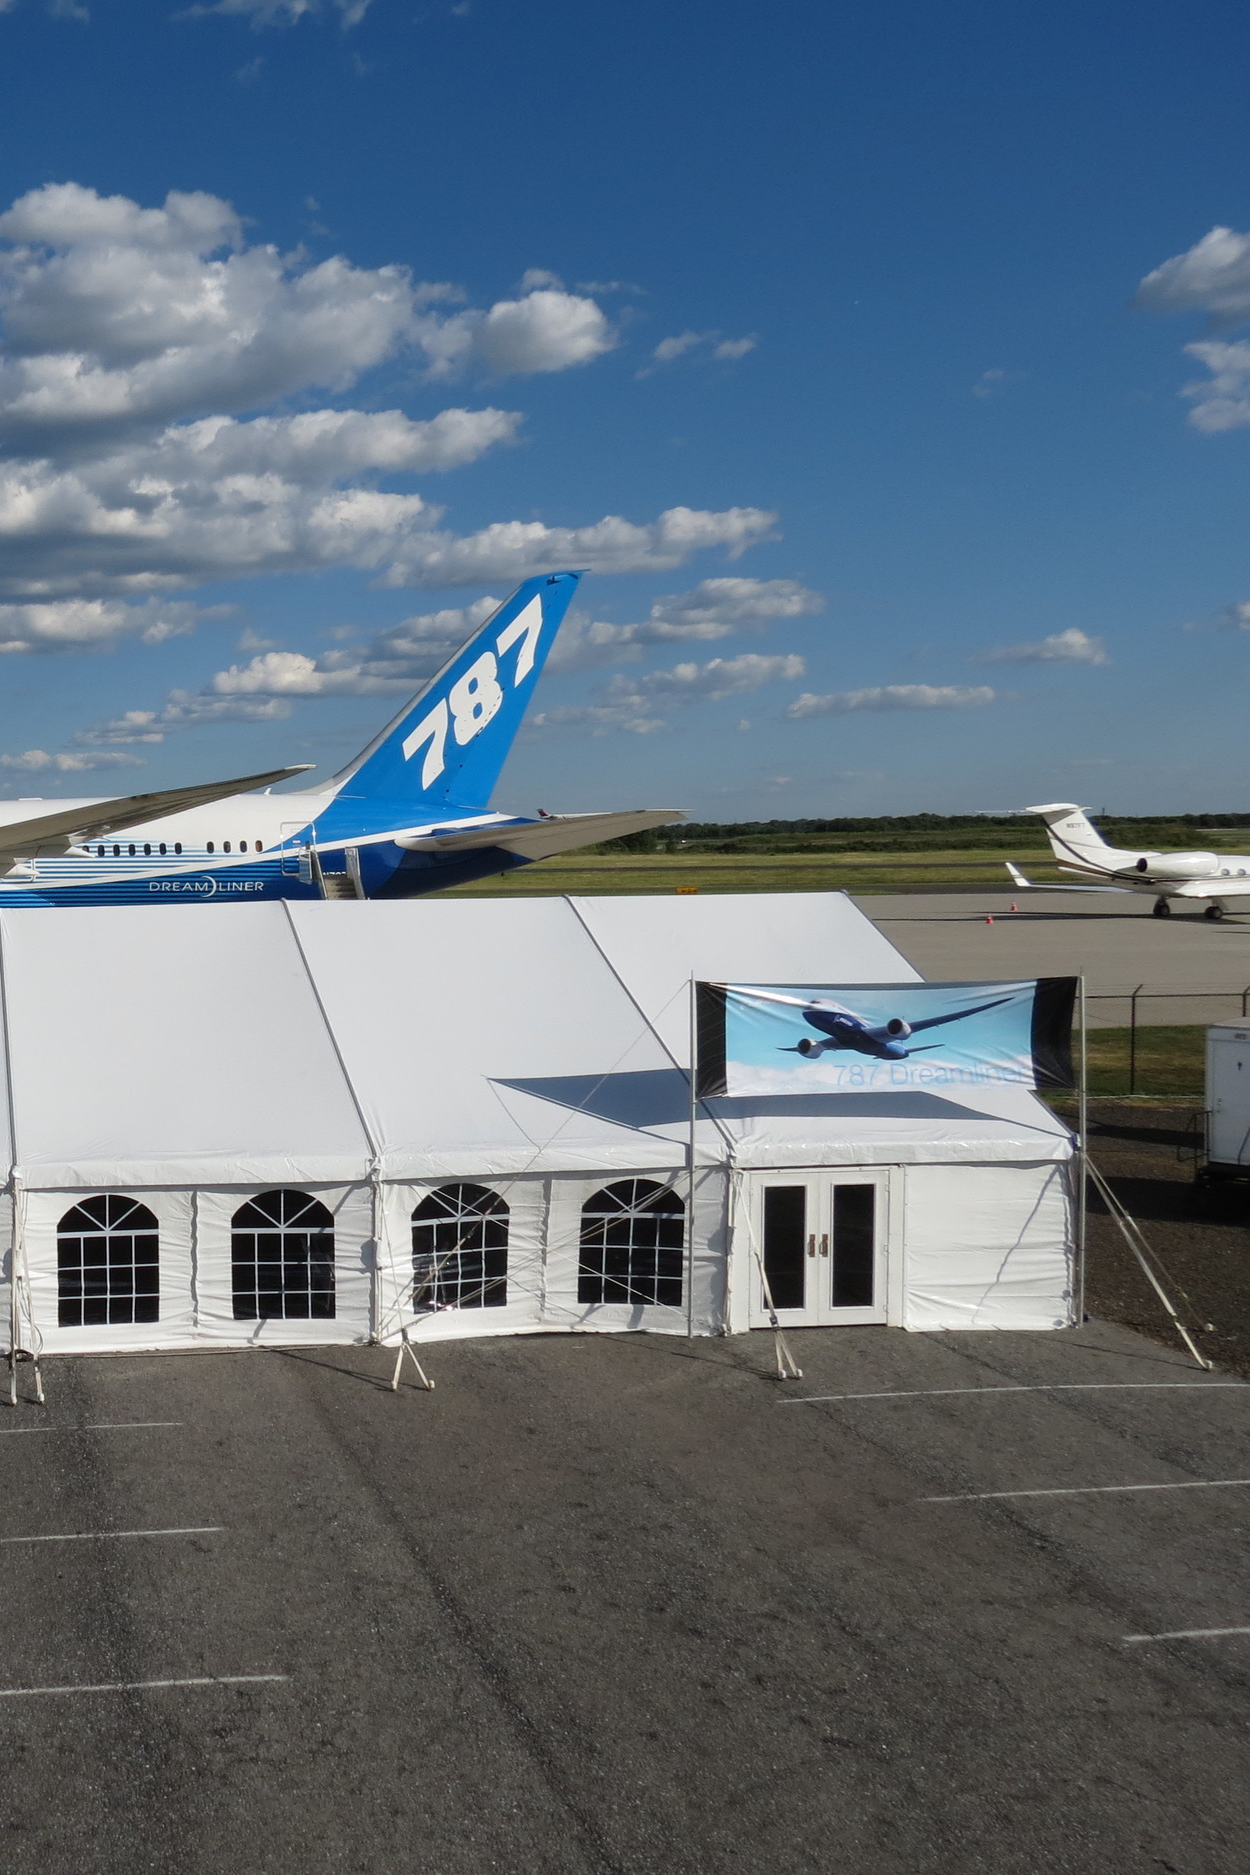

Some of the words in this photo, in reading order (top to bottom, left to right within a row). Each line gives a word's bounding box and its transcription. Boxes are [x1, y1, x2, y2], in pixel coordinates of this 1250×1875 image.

[402, 593, 543, 791] 787
[833, 1065, 879, 1086] 787
[890, 1063, 1028, 1085] Dreamliner
